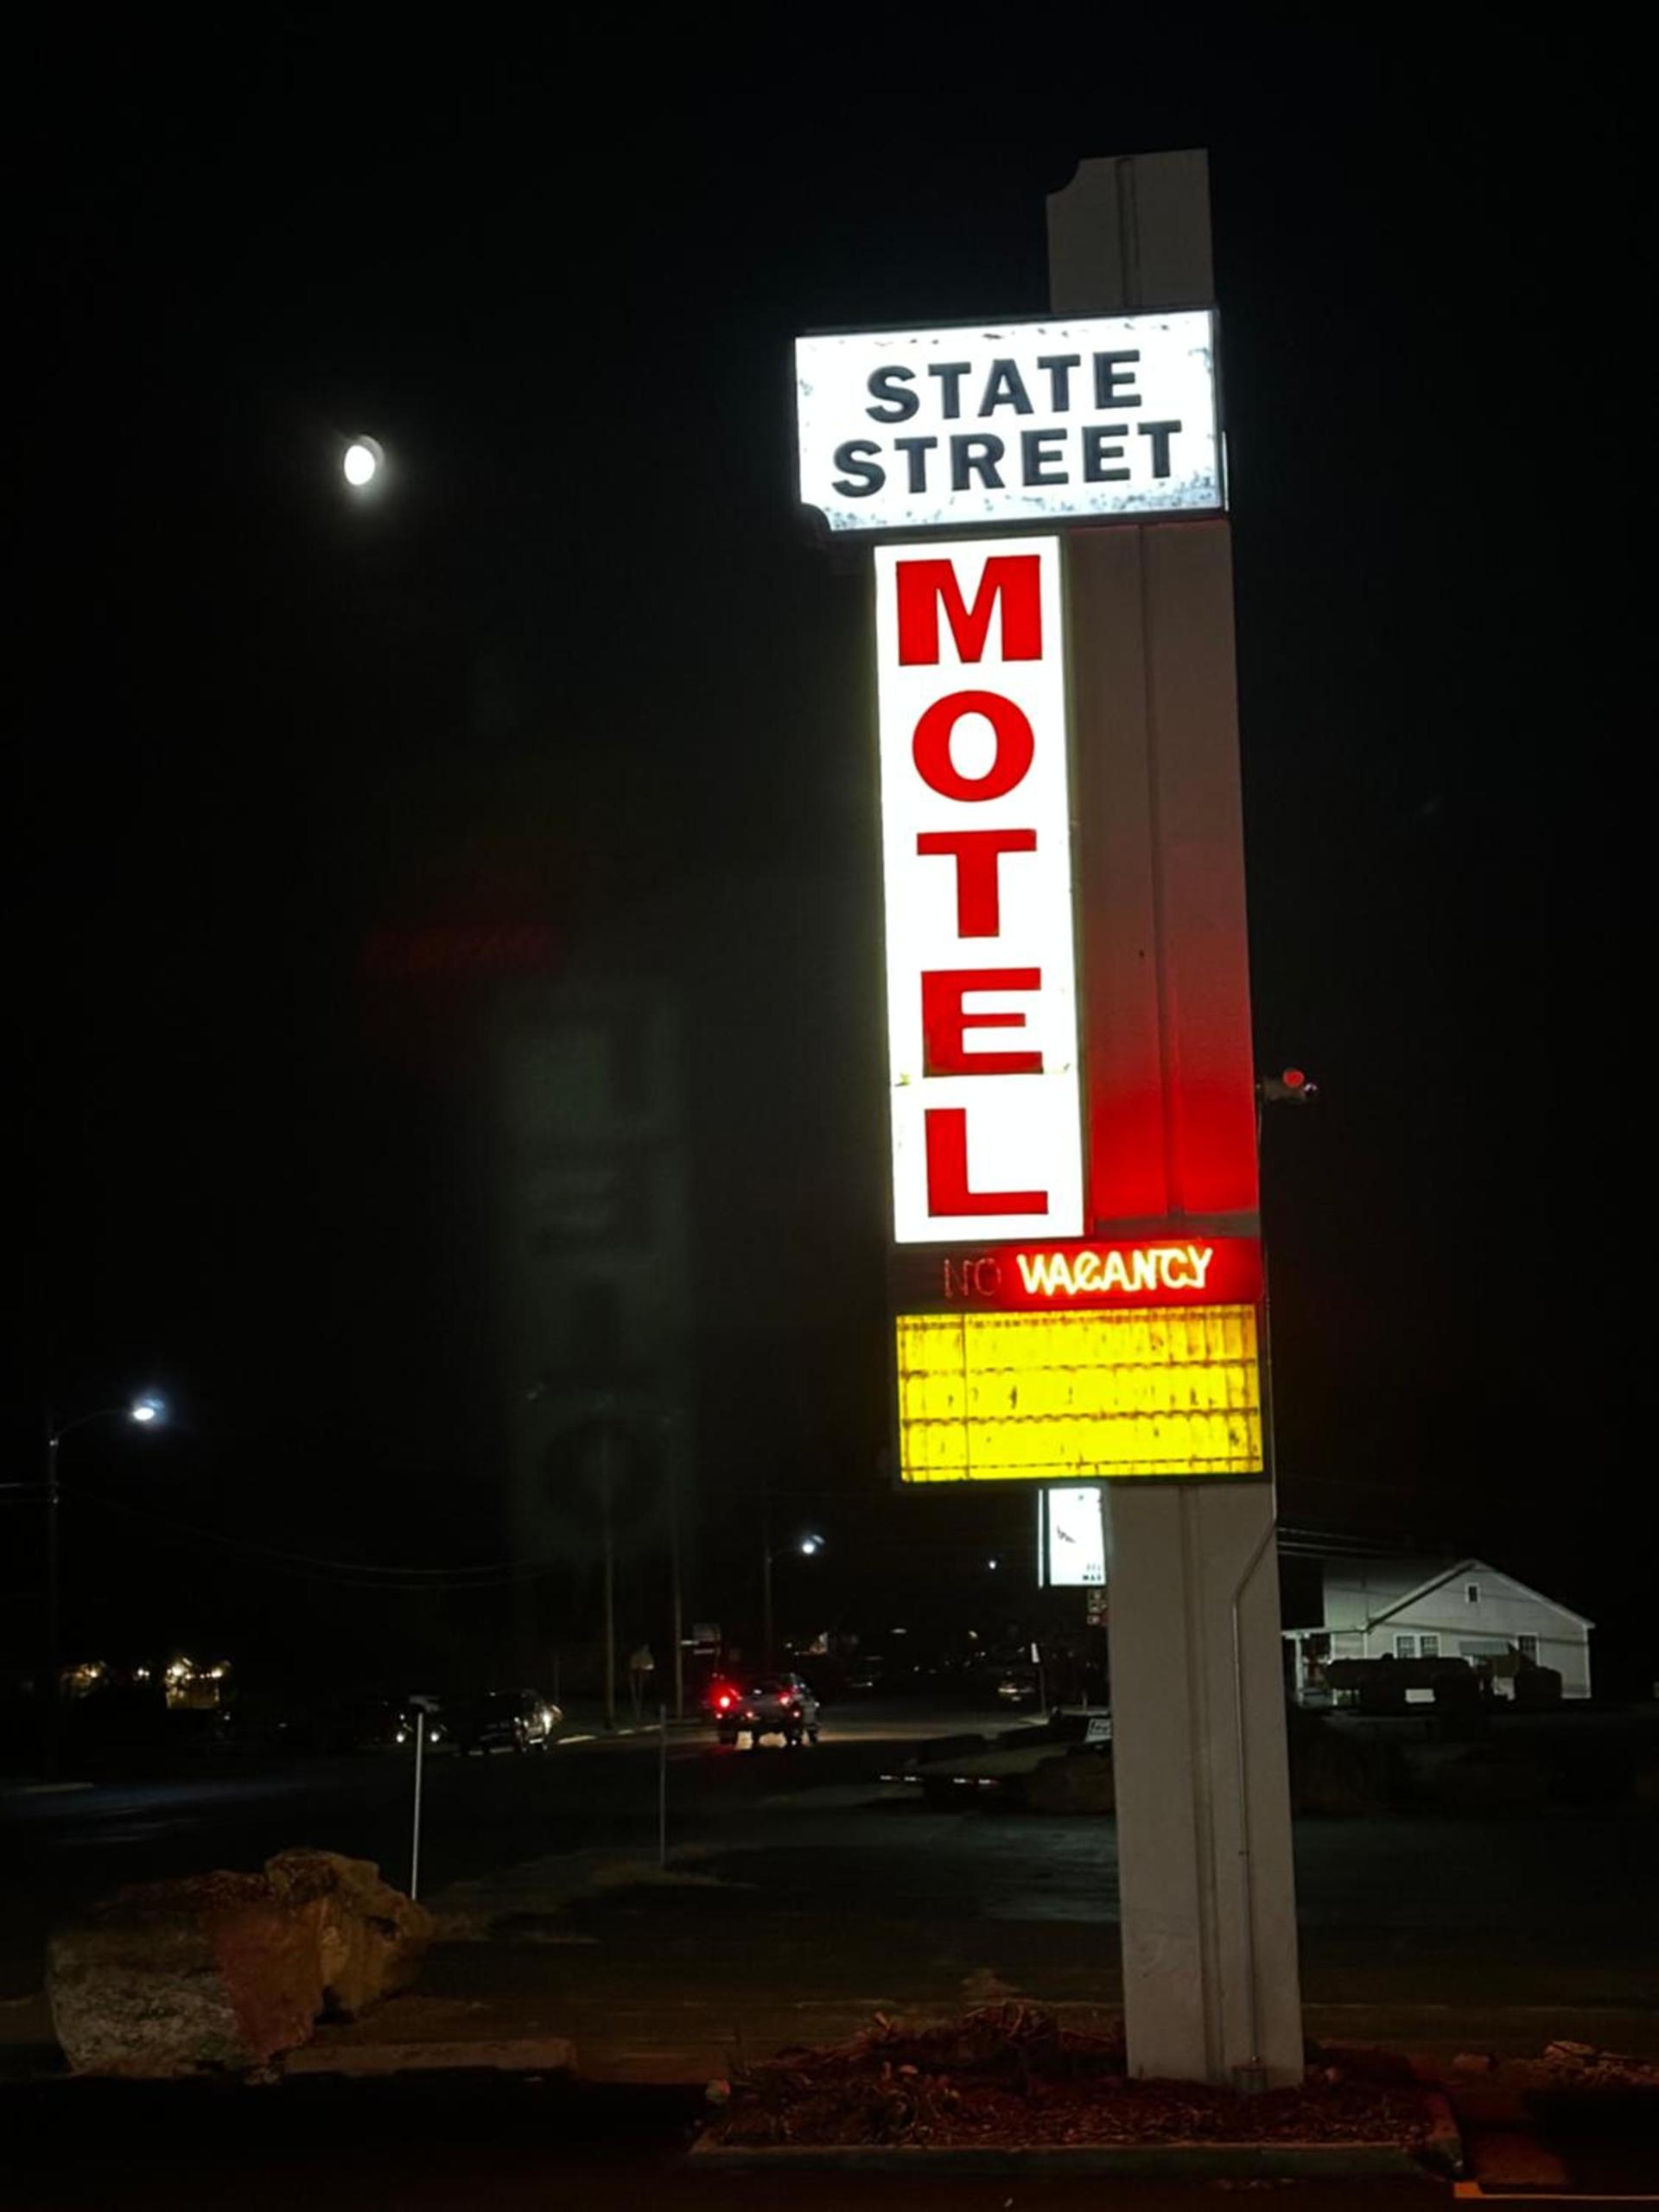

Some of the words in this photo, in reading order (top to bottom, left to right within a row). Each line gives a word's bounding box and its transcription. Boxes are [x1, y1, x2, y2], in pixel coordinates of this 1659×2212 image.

[865, 348, 1142, 424] STATE
[831, 419, 1183, 499] STREET
[895, 554, 1049, 1217] MOTEL
[944, 1257, 1001, 1297] NO
[1016, 1245, 1213, 1296] VACANCY
